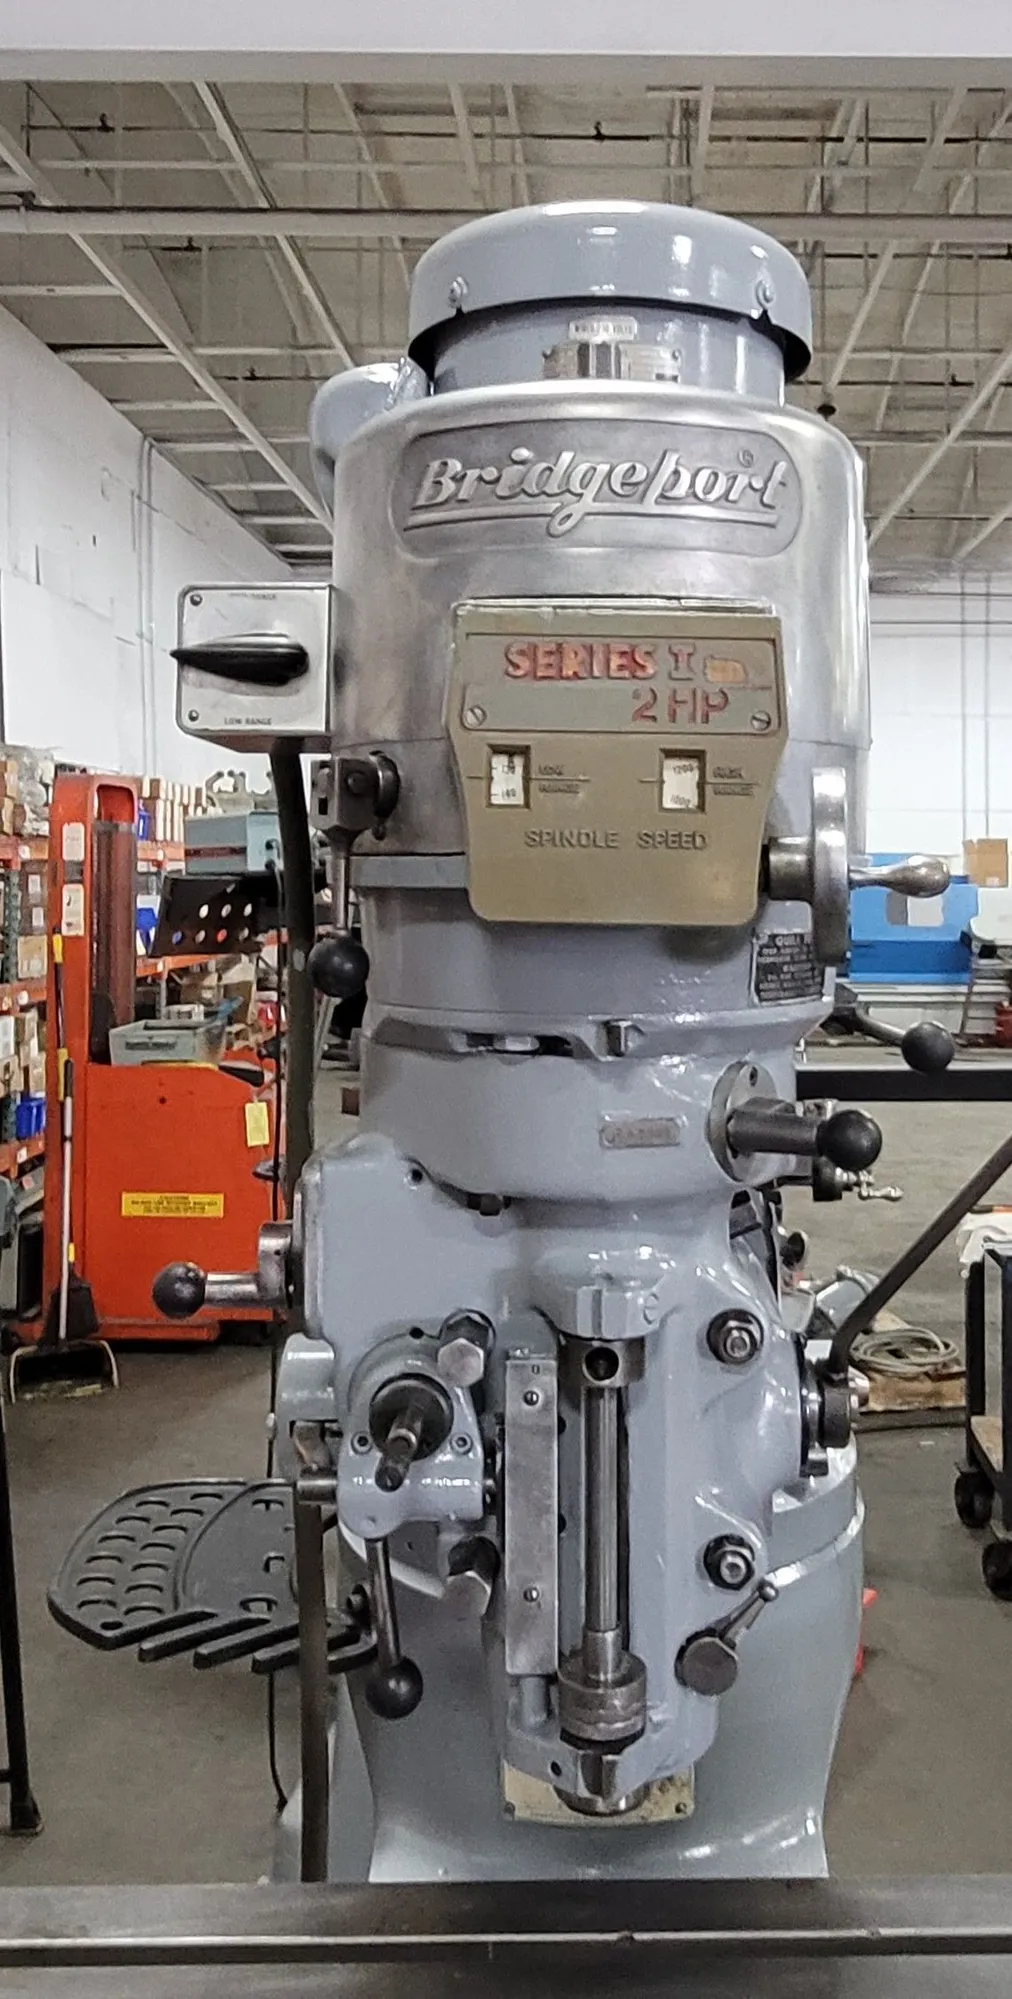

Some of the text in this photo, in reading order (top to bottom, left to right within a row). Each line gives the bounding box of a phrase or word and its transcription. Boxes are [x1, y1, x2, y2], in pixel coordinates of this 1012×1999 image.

[411, 447, 789, 538] Bridgeport
[504, 641, 697, 681] SERIES I
[631, 687, 730, 724] 2 HP
[524, 828, 708, 851] SPINDLE SPEED
